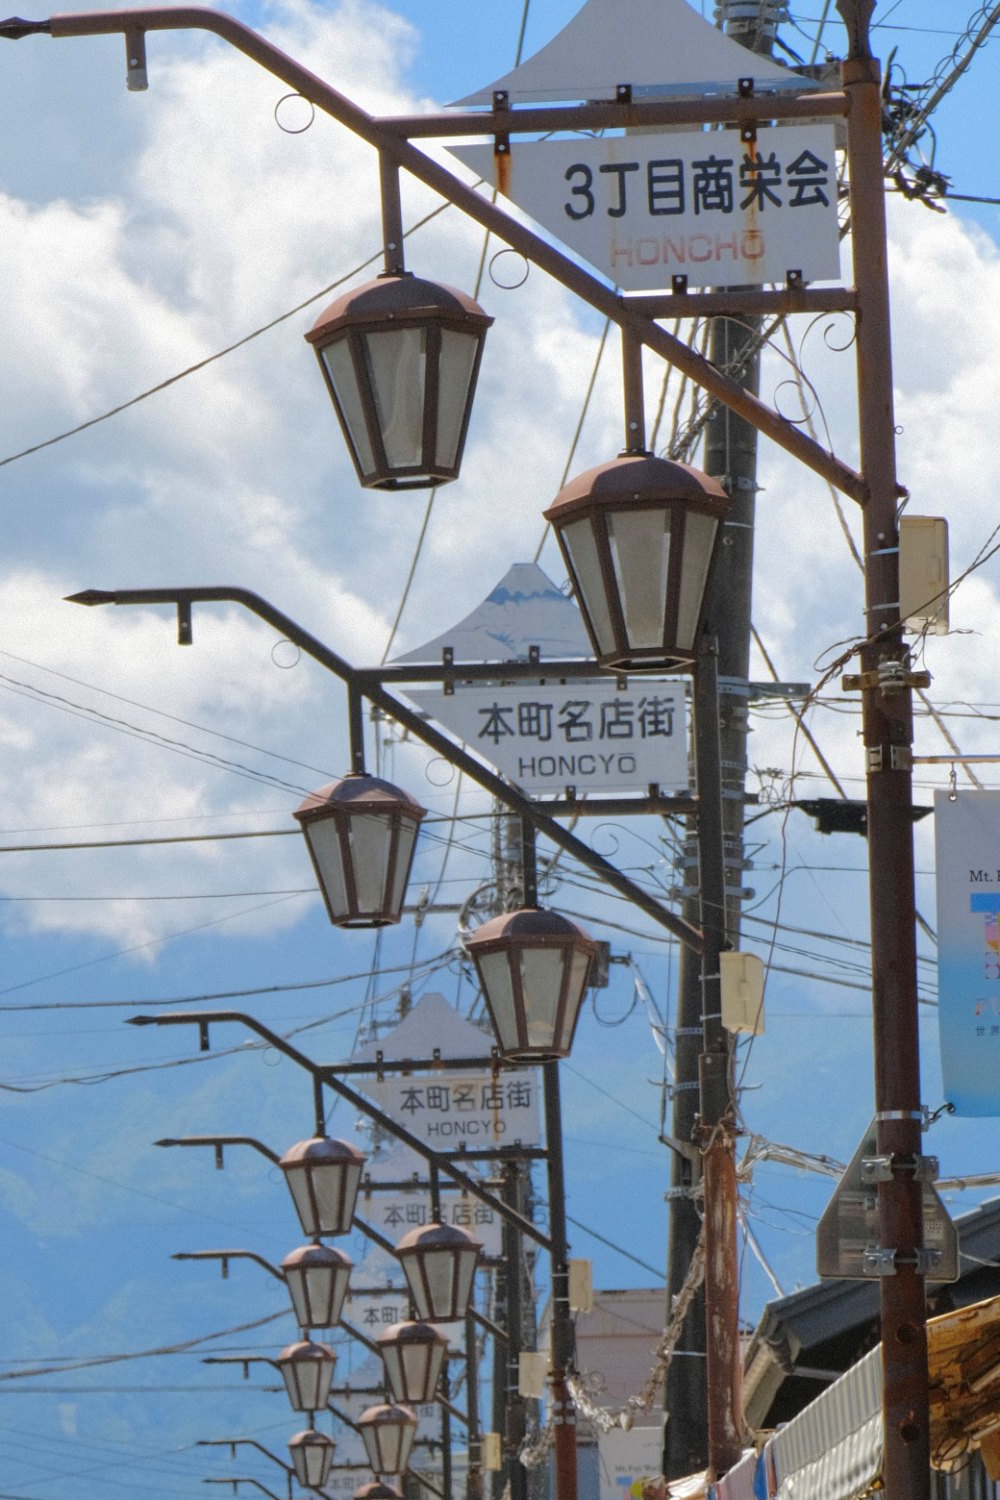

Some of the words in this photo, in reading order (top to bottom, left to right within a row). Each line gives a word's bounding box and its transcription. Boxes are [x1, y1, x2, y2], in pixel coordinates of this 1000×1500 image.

[564, 150, 829, 220] 3丁目商栄会
[478, 697, 675, 745] 本町名店街
[400, 1081, 531, 1115] 本町名店街
